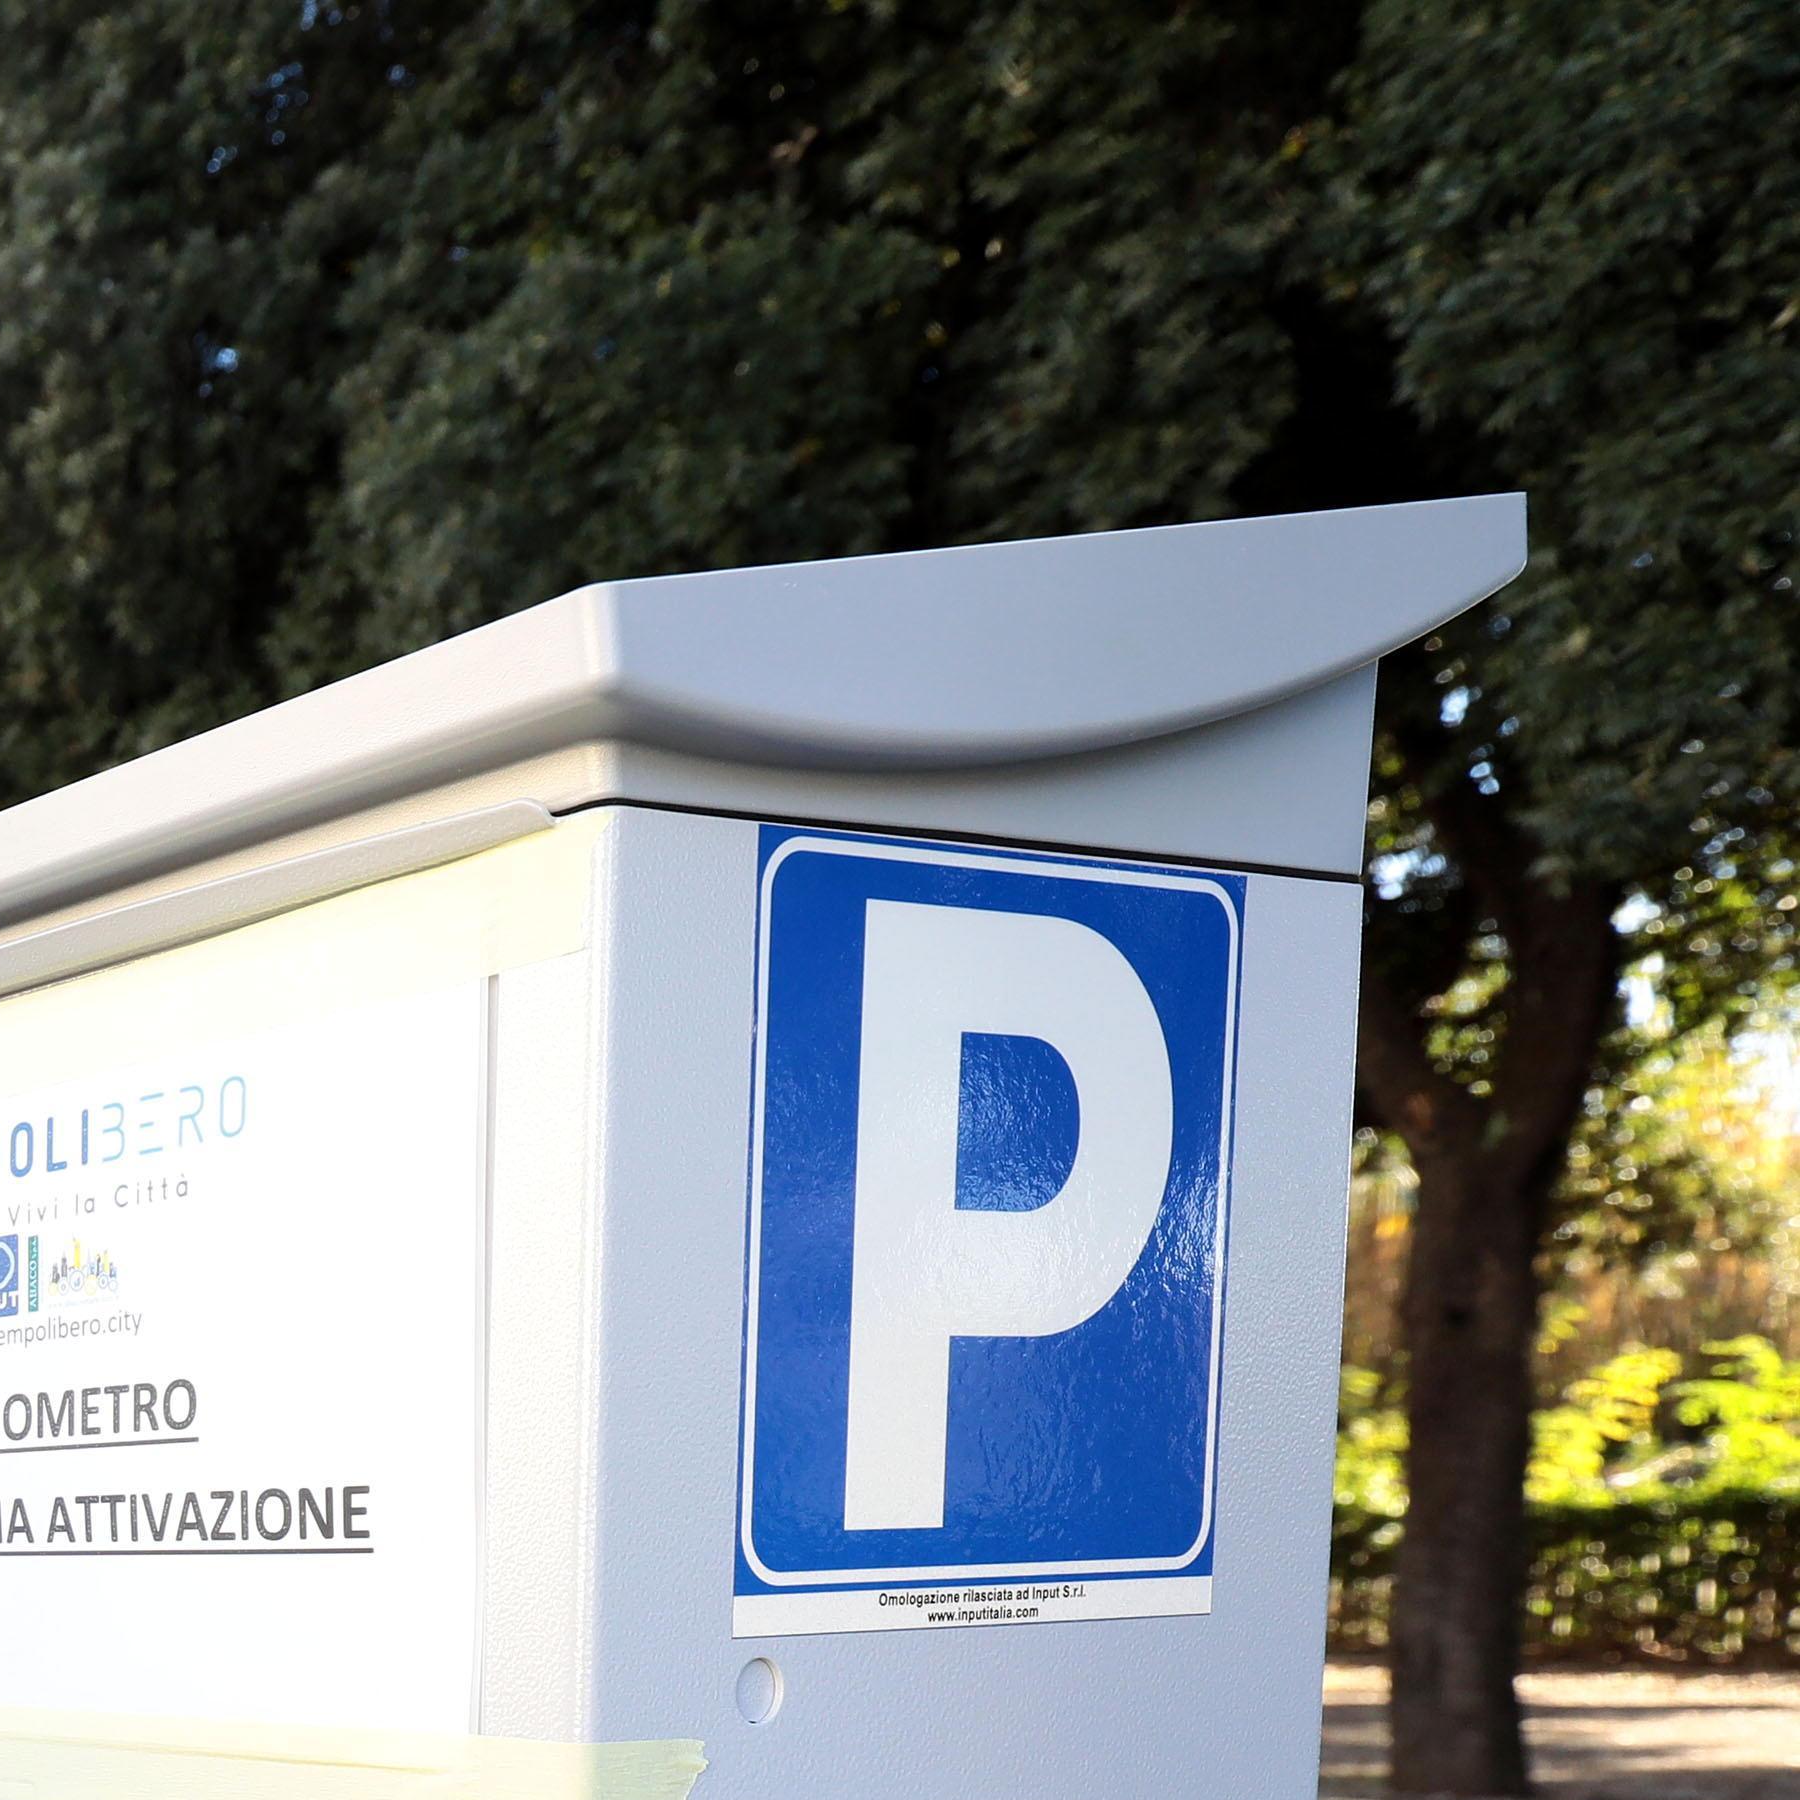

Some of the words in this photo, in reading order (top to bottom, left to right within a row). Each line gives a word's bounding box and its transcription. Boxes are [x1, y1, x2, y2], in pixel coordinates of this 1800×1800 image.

[7, 1196, 58, 1227] Vivi
[74, 1194, 96, 1215] la
[113, 1174, 188, 1208] Città
[844, 897, 1174, 1531] P
[46, 1485, 372, 1544] ATTIVAZIONE
[878, 1590, 960, 1608] Omologazione
[962, 1587, 1013, 1602] rilasciata
[1016, 1587, 1030, 1601] ad
[1031, 1586, 1061, 1603] Input
[927, 1605, 1039, 1623] www.inputitalia.com
